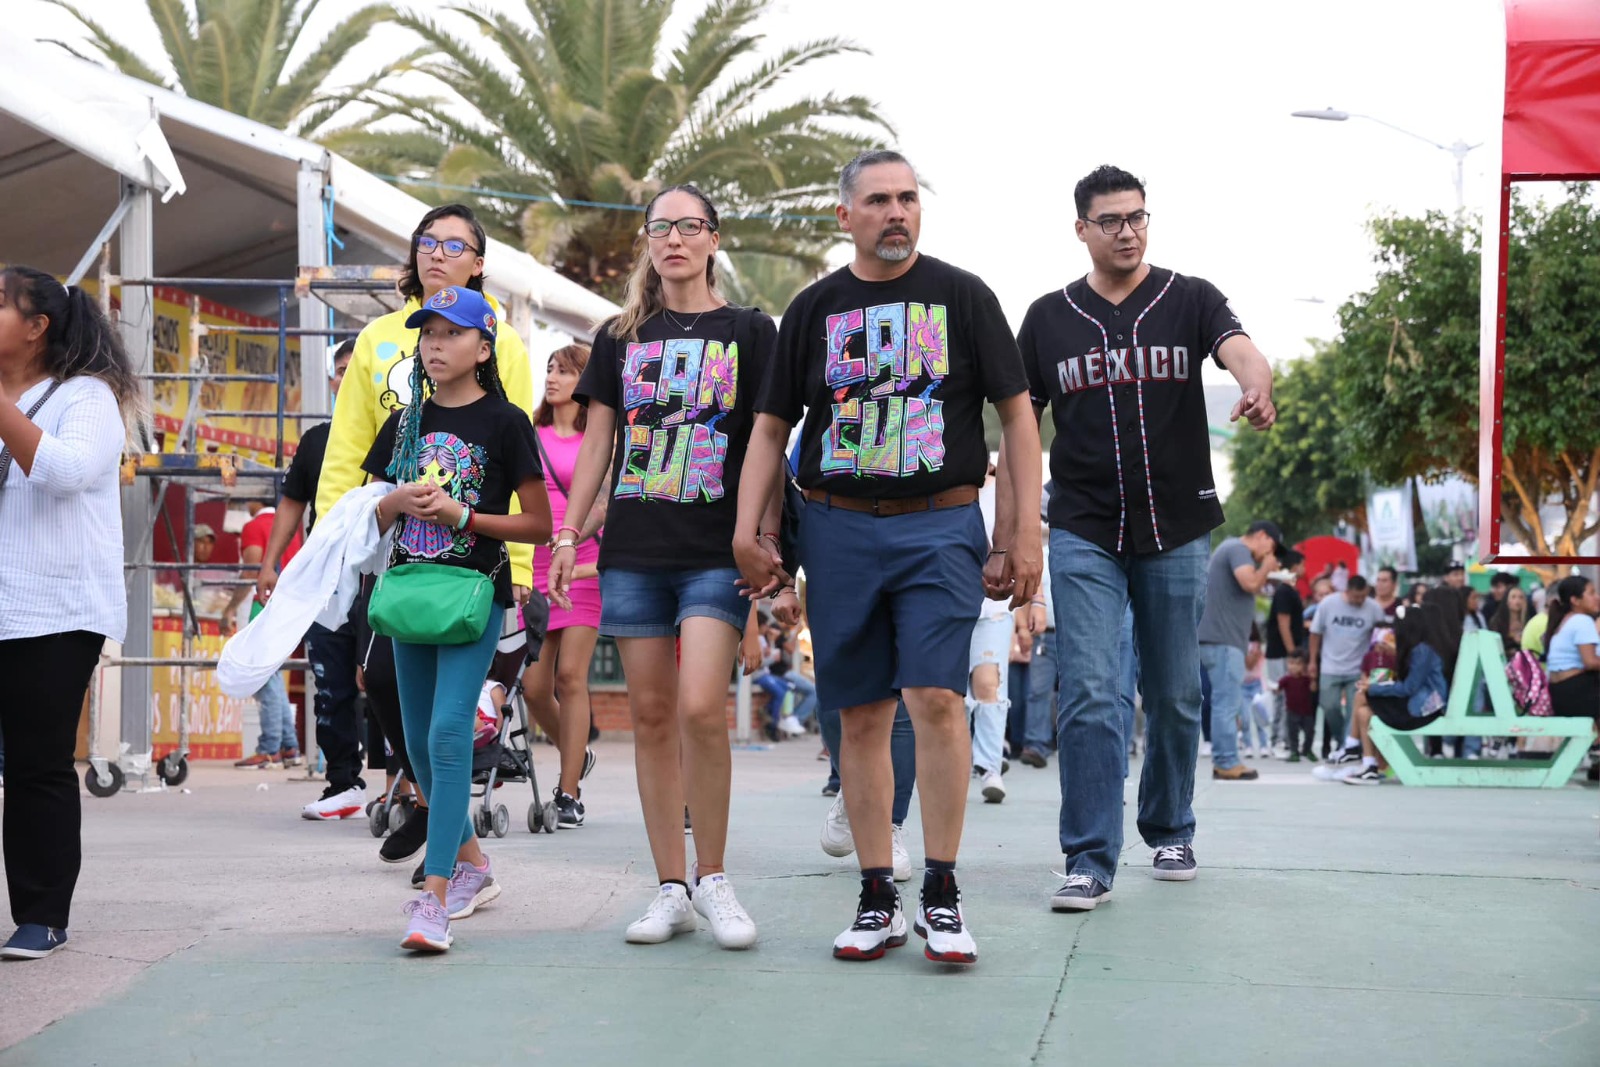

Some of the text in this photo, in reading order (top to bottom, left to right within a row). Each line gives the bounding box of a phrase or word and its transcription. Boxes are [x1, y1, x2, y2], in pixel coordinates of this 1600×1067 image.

[622, 338, 738, 410] CAN
[824, 302, 948, 388] CAN
[1056, 347, 1189, 394] MÉXICO
